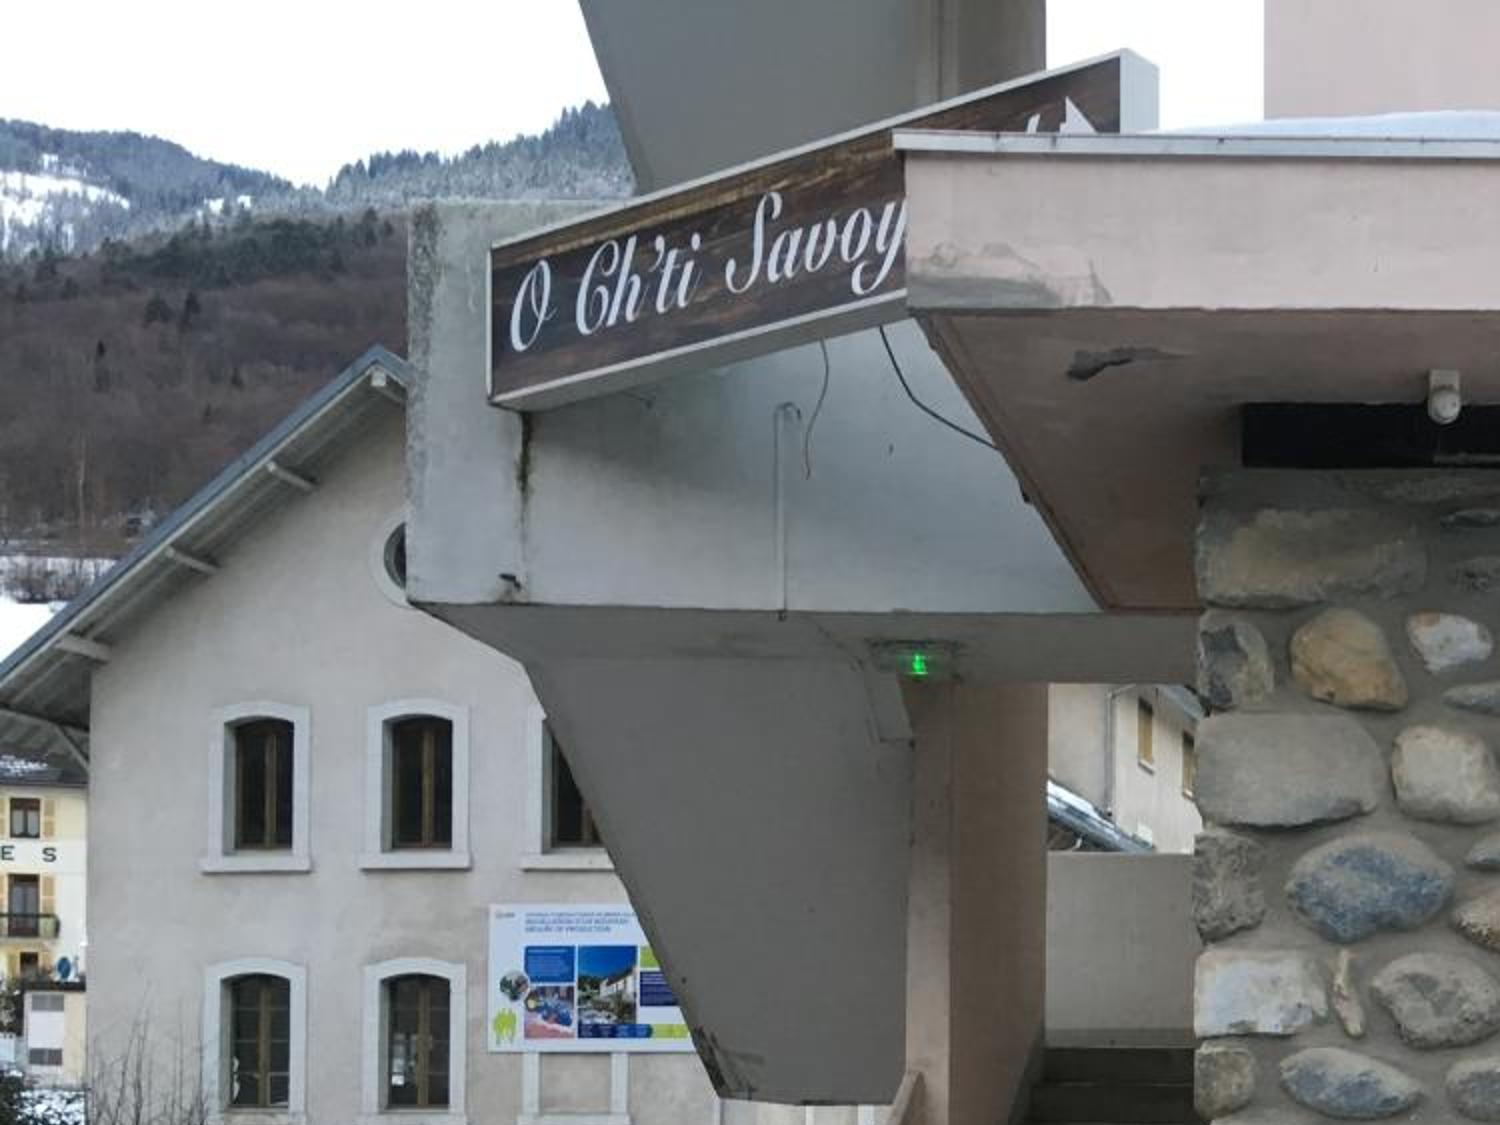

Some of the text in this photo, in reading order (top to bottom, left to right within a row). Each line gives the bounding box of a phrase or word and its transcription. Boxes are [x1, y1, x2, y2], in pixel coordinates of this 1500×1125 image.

[510, 192, 907, 351] O Ch'ti Savoy
